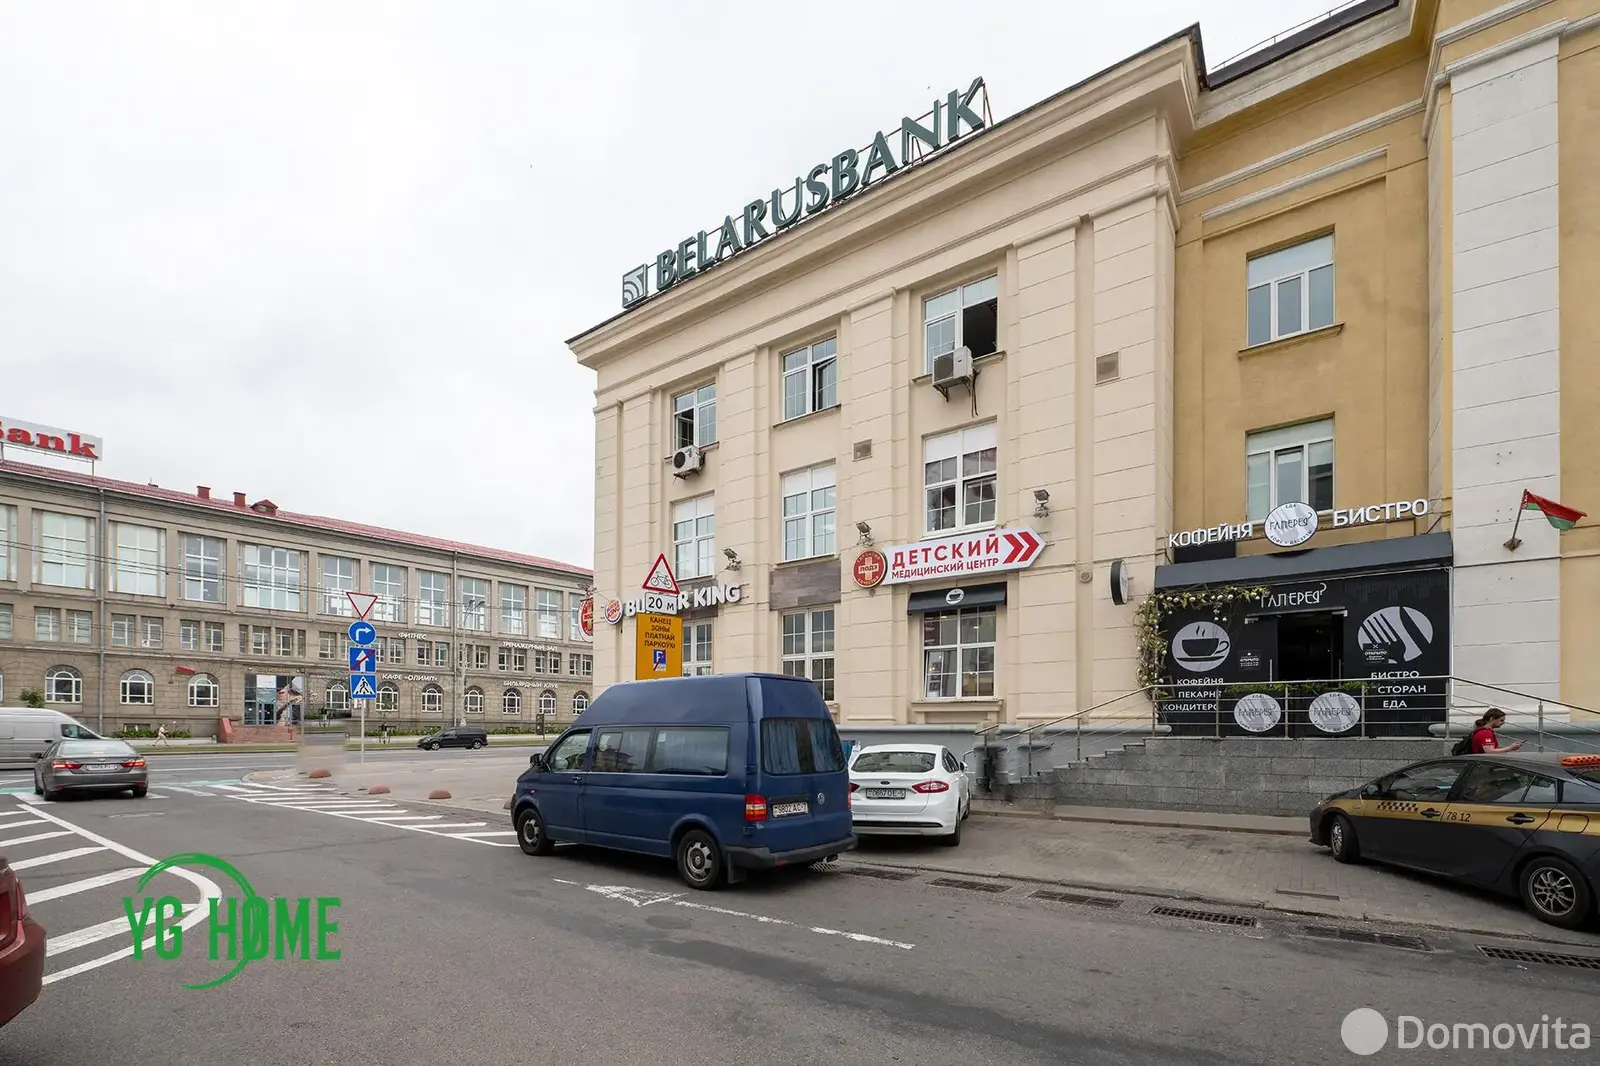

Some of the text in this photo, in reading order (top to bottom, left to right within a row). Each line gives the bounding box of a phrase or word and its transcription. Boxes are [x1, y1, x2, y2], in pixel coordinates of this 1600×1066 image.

[656, 76, 985, 292] BELARUSBANK
[0, 421, 99, 459] ank
[1332, 498, 1430, 528] БИСТРО
[1168, 521, 1254, 548] КОФЕЙНЯ
[892, 533, 1000, 570] ДЕТСКИЙ
[891, 557, 1000, 580] МЕДИЦИНСКИЙ ЦЕНТР
[693, 584, 741, 608] KING
[648, 597, 663, 610] 20
[650, 617, 672, 626] КАНЕЦ
[651, 625, 670, 633] ЗОНЫ
[398, 632, 428, 640] ФИТНЕС
[1370, 670, 1420, 679] БИСТРО
[1177, 677, 1224, 686] КОФЕЙНЯ
[1382, 699, 1408, 709] ЕДА
[1446, 811, 1471, 822] 78 12
